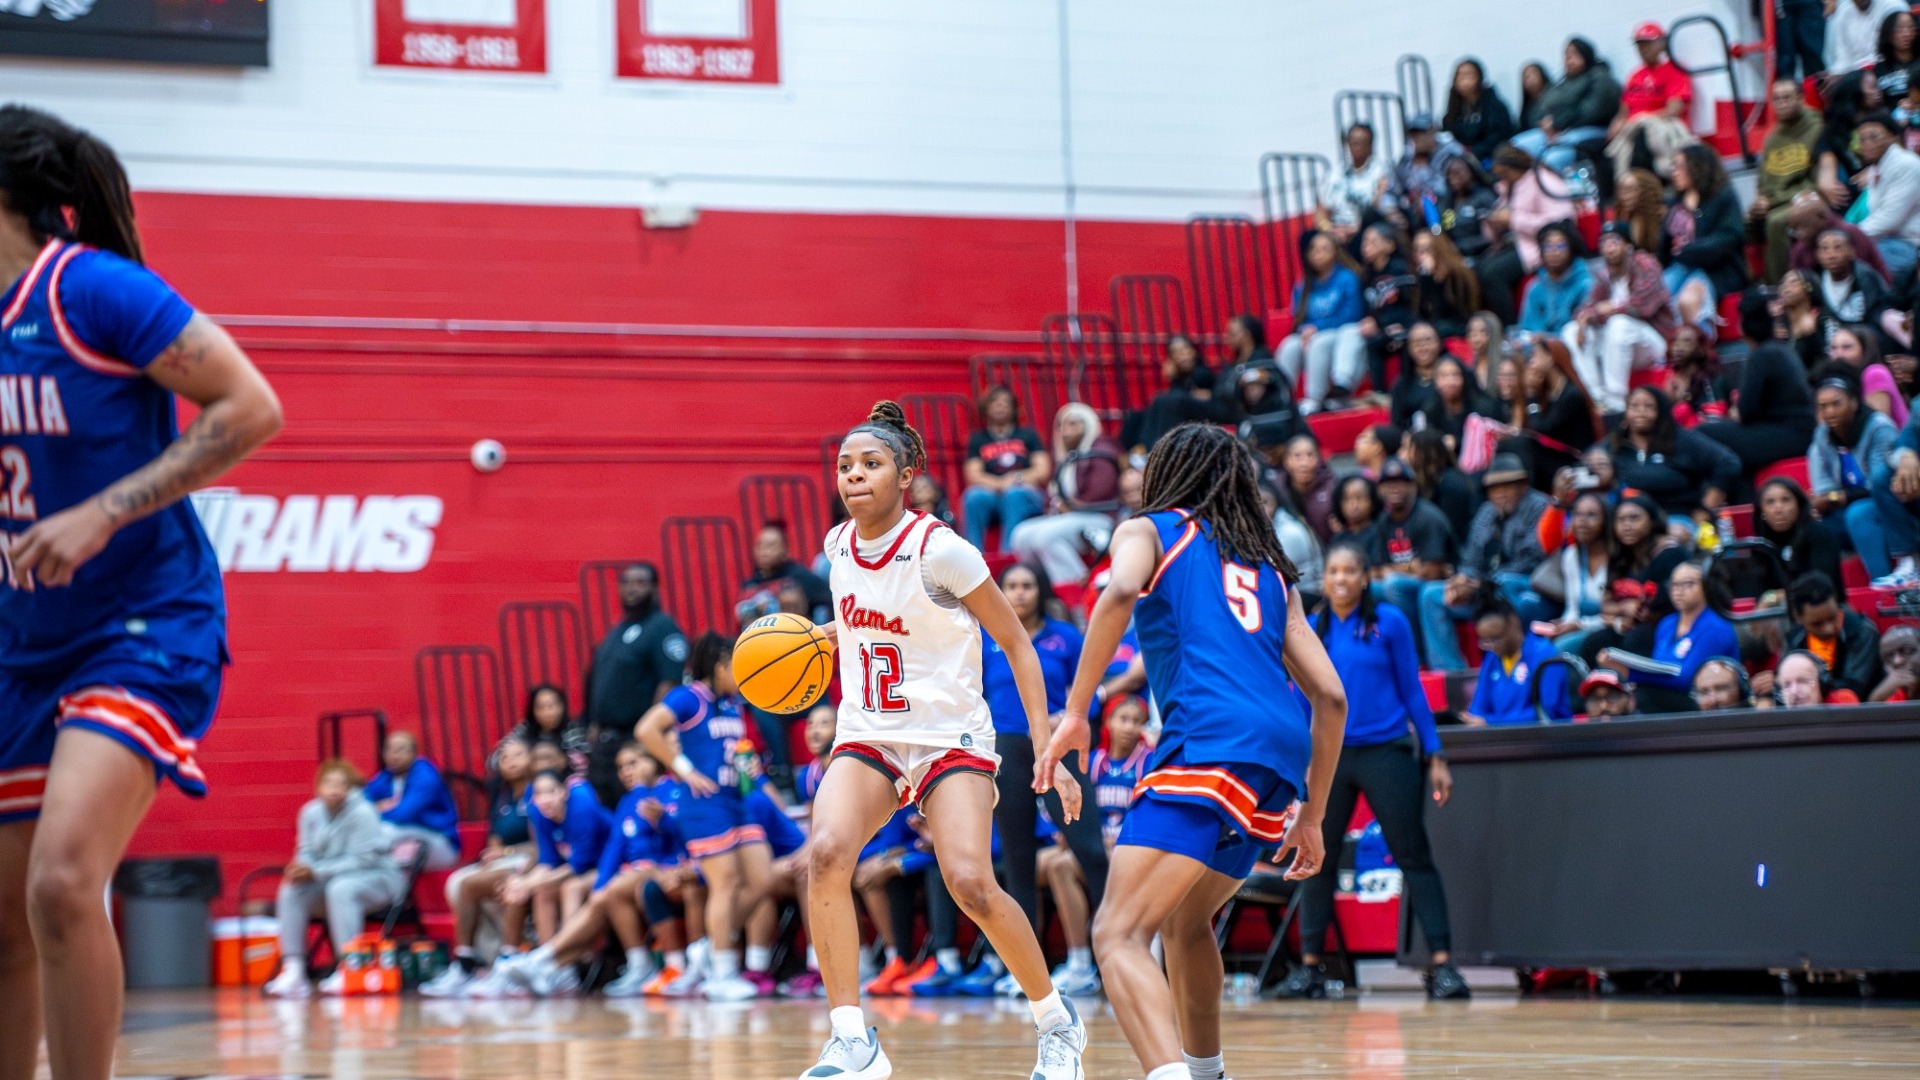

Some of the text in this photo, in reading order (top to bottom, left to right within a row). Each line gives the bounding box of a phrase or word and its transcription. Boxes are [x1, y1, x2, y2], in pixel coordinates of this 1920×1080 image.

[220, 493, 444, 574] RAMS
[840, 593, 910, 636] Rams
[1221, 560, 1263, 633] 5
[859, 642, 911, 713] 12
